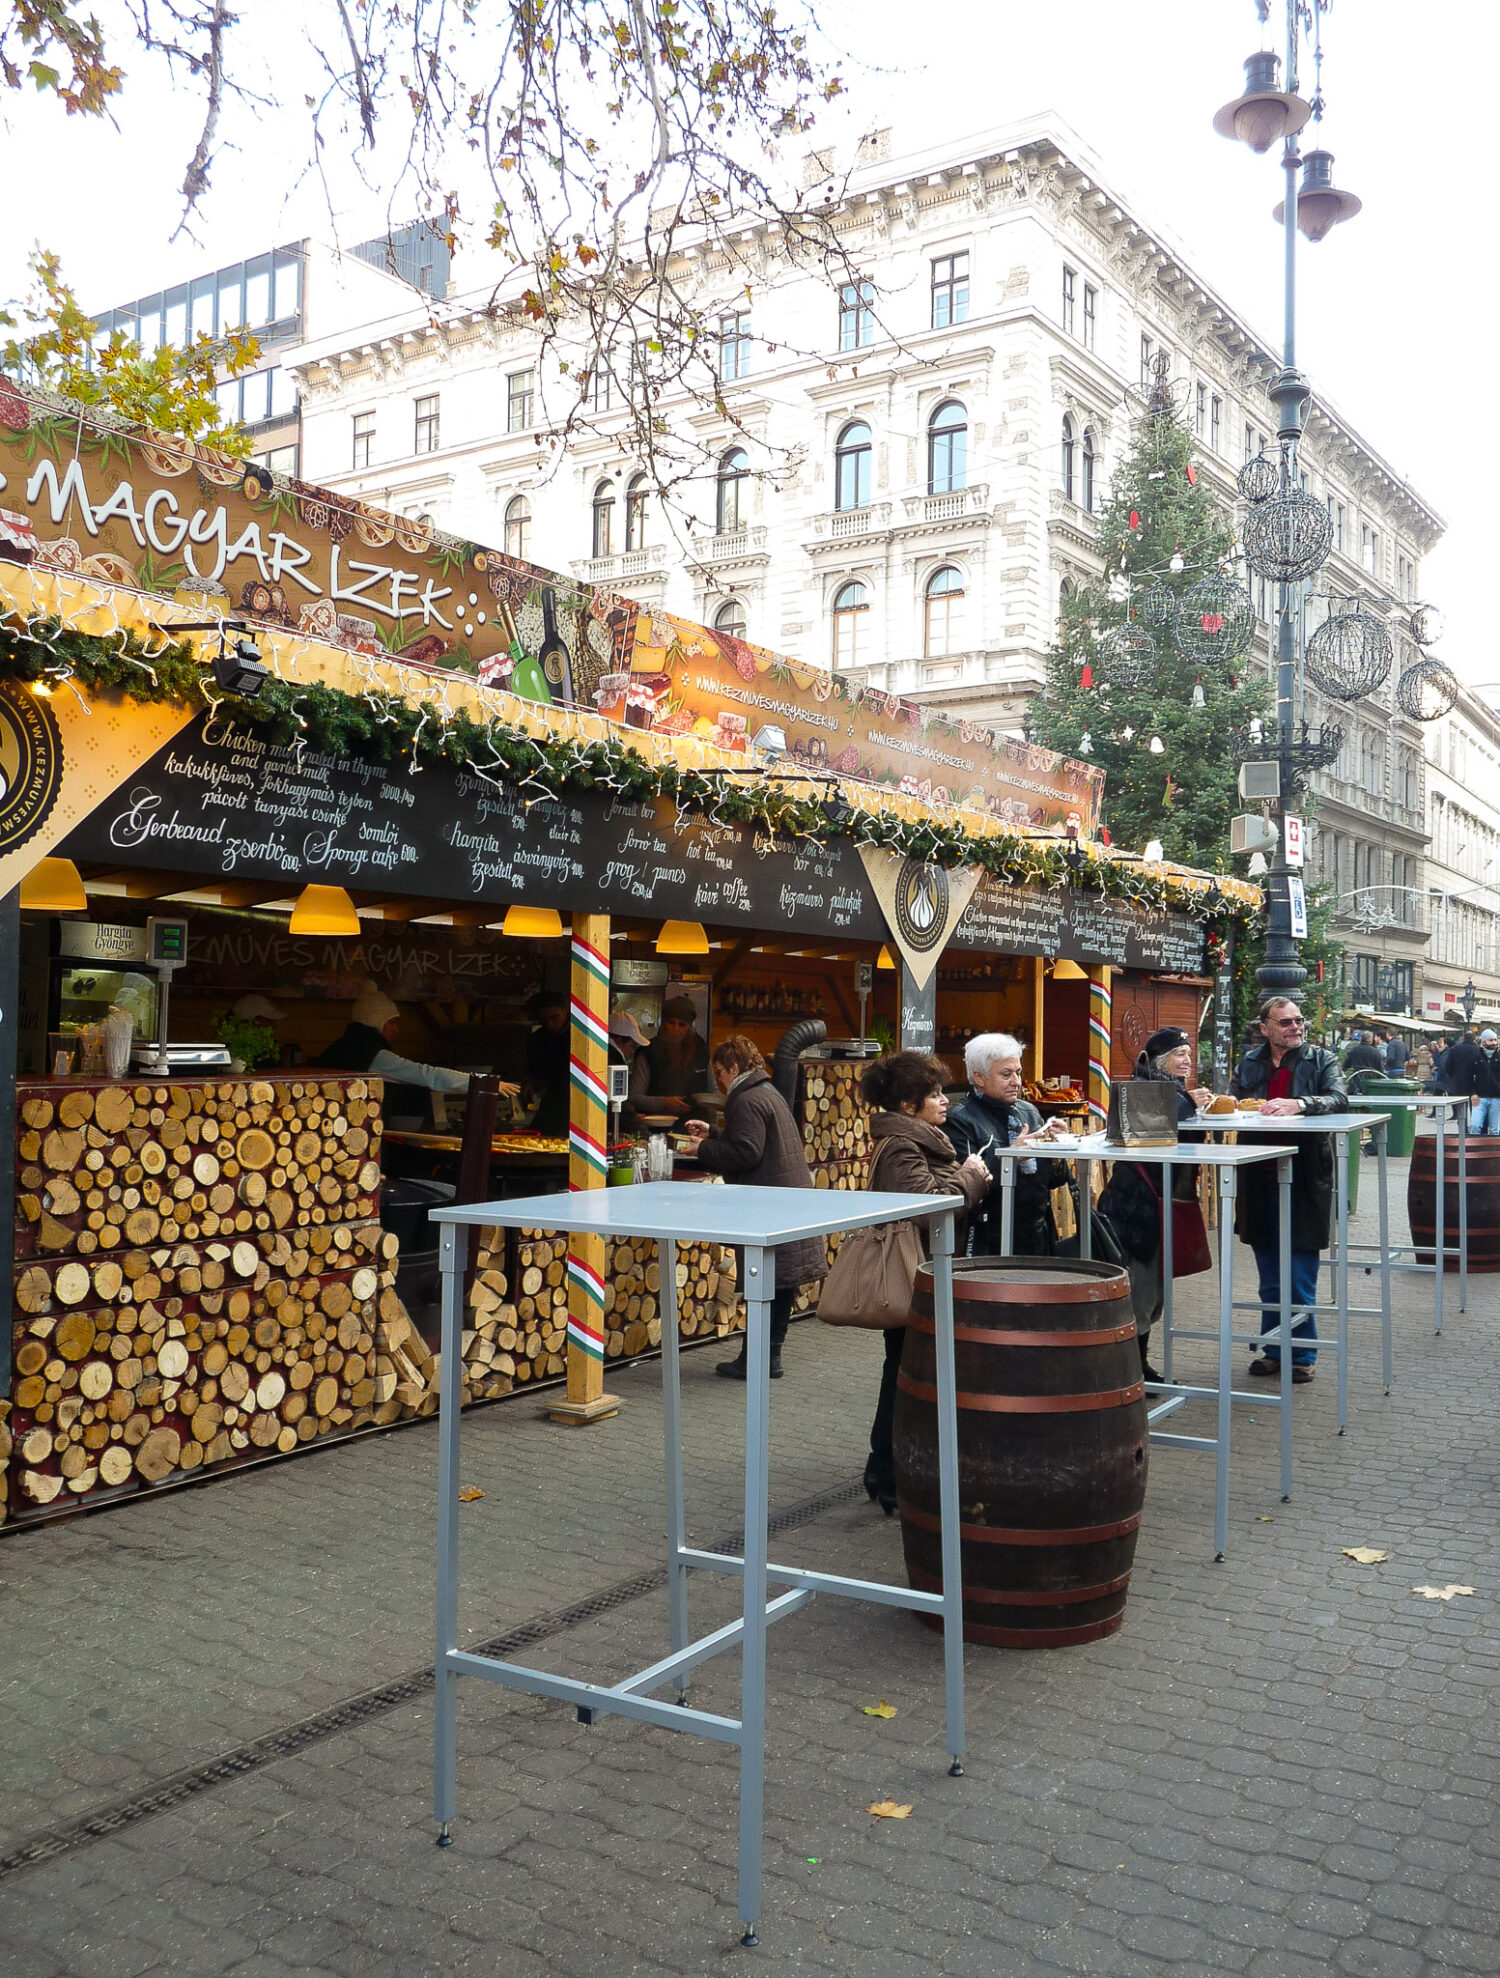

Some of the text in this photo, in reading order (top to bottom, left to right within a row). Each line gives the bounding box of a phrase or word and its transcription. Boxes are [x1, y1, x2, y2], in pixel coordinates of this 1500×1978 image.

[26, 457, 324, 597] MAGYAR
[0, 694, 47, 836] WWW.KEZMUVESM
[201, 717, 266, 755] Chicken
[351, 754, 388, 785] thyme
[231, 752, 259, 770] and
[302, 766, 331, 784] milk
[110, 786, 227, 848] Gerbeaud
[201, 786, 348, 829] pácolt tanyasi csirke
[338, 788, 374, 816] tejben
[303, 829, 369, 875] Sponge
[371, 844, 400, 870] cake
[450, 820, 500, 861] hargita
[653, 837, 667, 854] tea
[686, 840, 702, 860] hot
[704, 844, 717, 863] tea
[599, 860, 641, 889] grog
[651, 866, 687, 890] puncs
[694, 882, 720, 907] kávé
[723, 877, 749, 905] coffee
[94, 937, 135, 953] Gyöngye
[96, 922, 133, 940] Hargita
